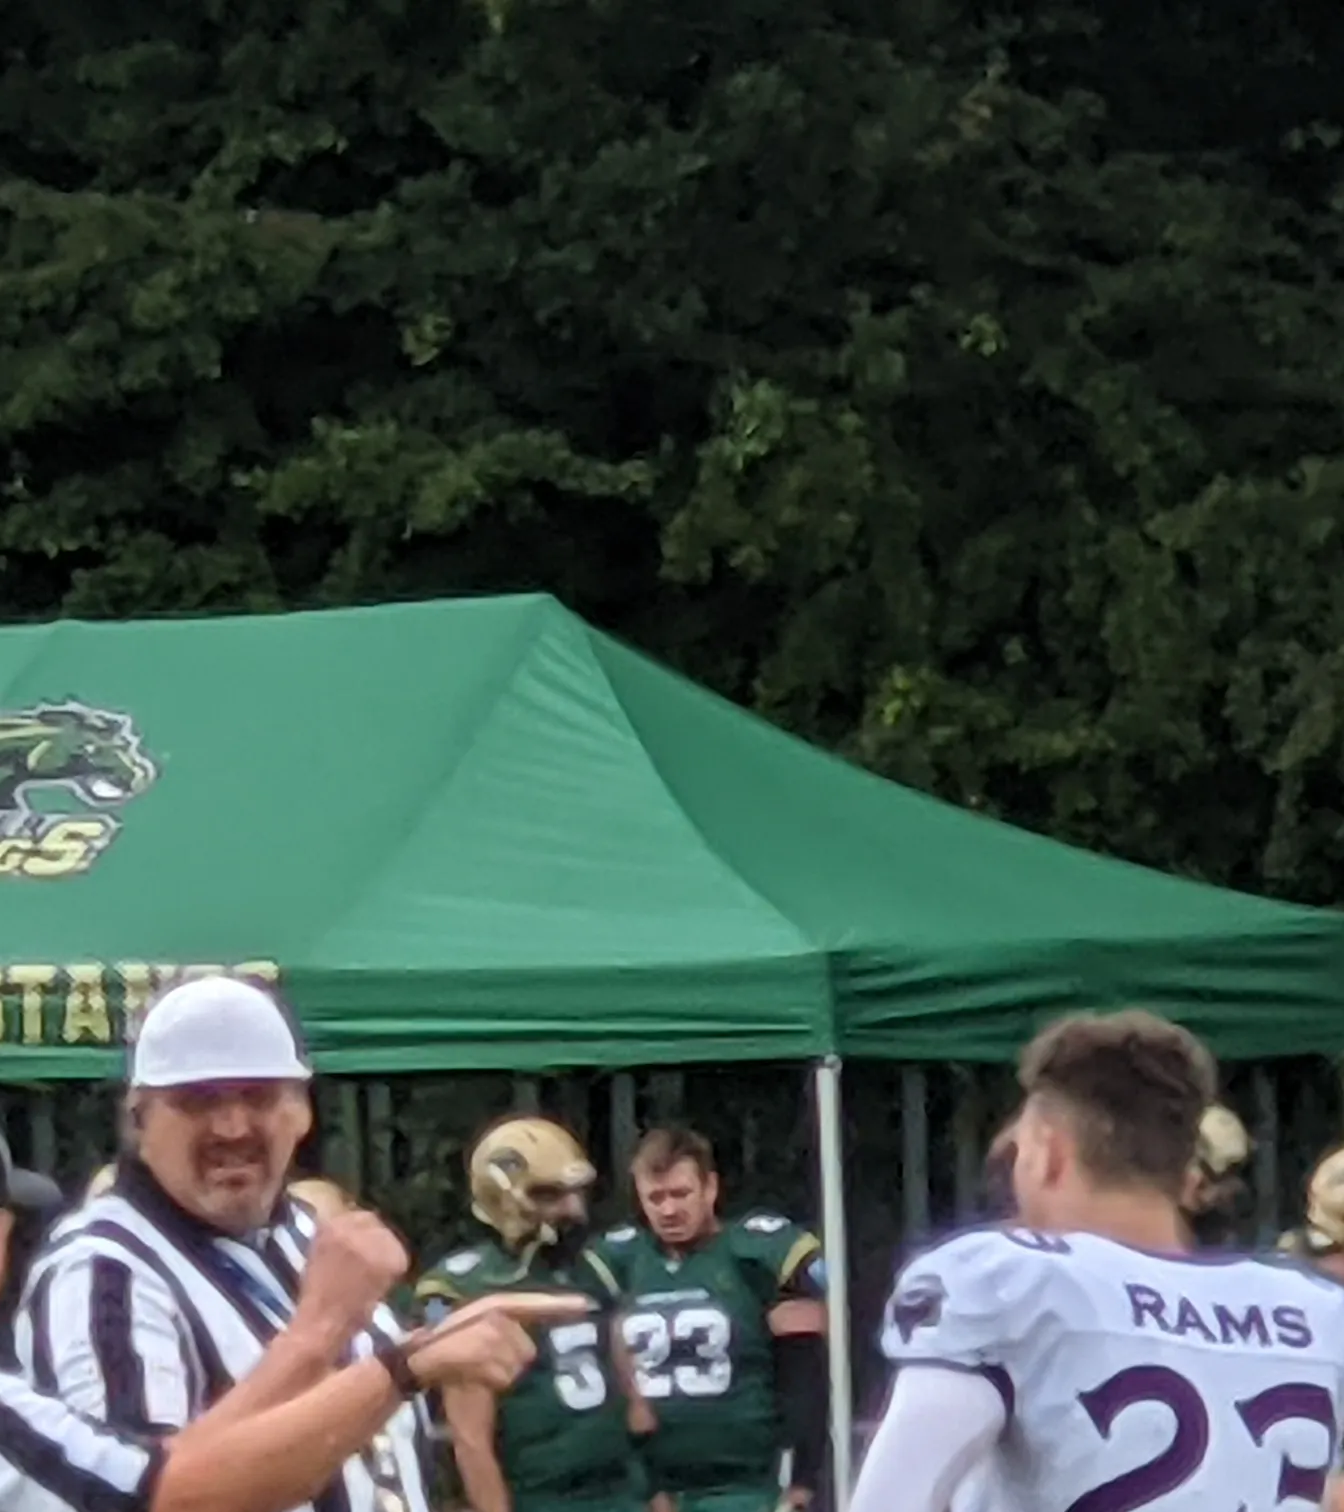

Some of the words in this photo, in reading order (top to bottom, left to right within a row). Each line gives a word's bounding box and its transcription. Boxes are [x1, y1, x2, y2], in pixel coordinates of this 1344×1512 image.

[622, 1308, 732, 1398] 23
[1123, 1281, 1313, 1350] RAMS
[549, 1322, 607, 1411] 5
